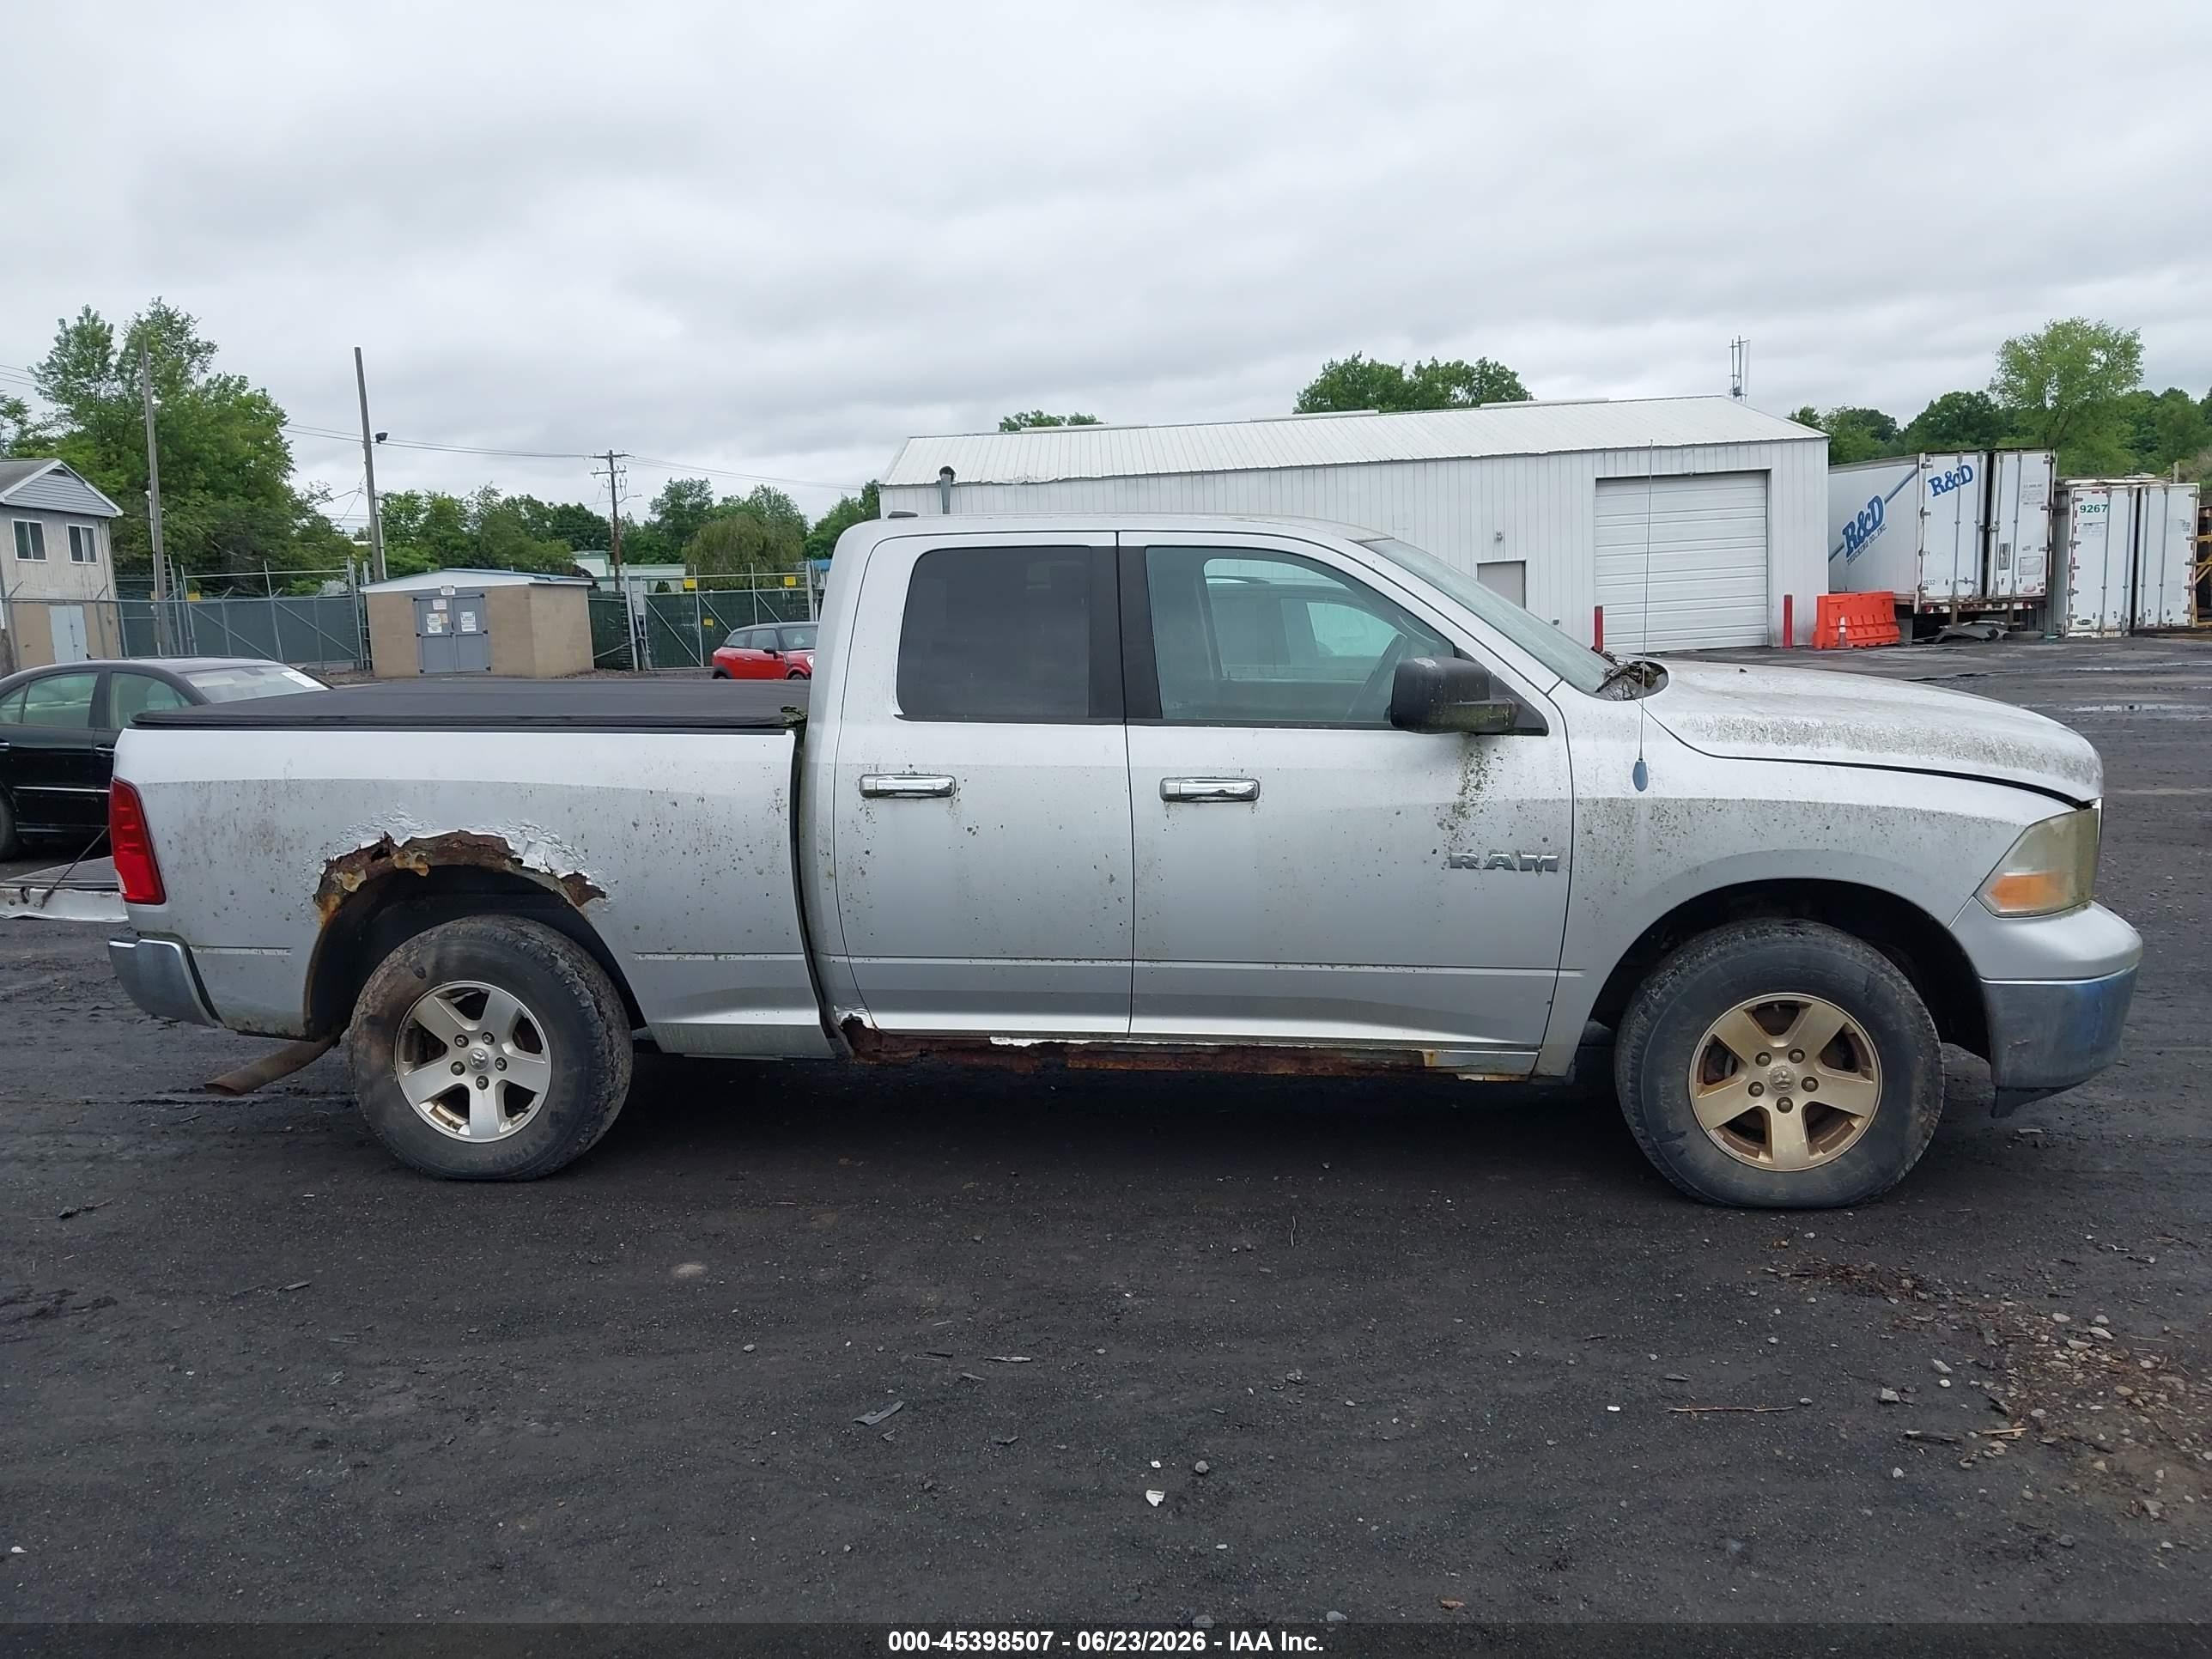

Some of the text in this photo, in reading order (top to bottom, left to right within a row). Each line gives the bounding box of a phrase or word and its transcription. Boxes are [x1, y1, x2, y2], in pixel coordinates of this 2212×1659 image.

[1927, 465, 1973, 497] R&D
[2079, 503, 2108, 514] 9267
[1841, 495, 1884, 558] R&D
[1449, 852, 1559, 876] RAM
